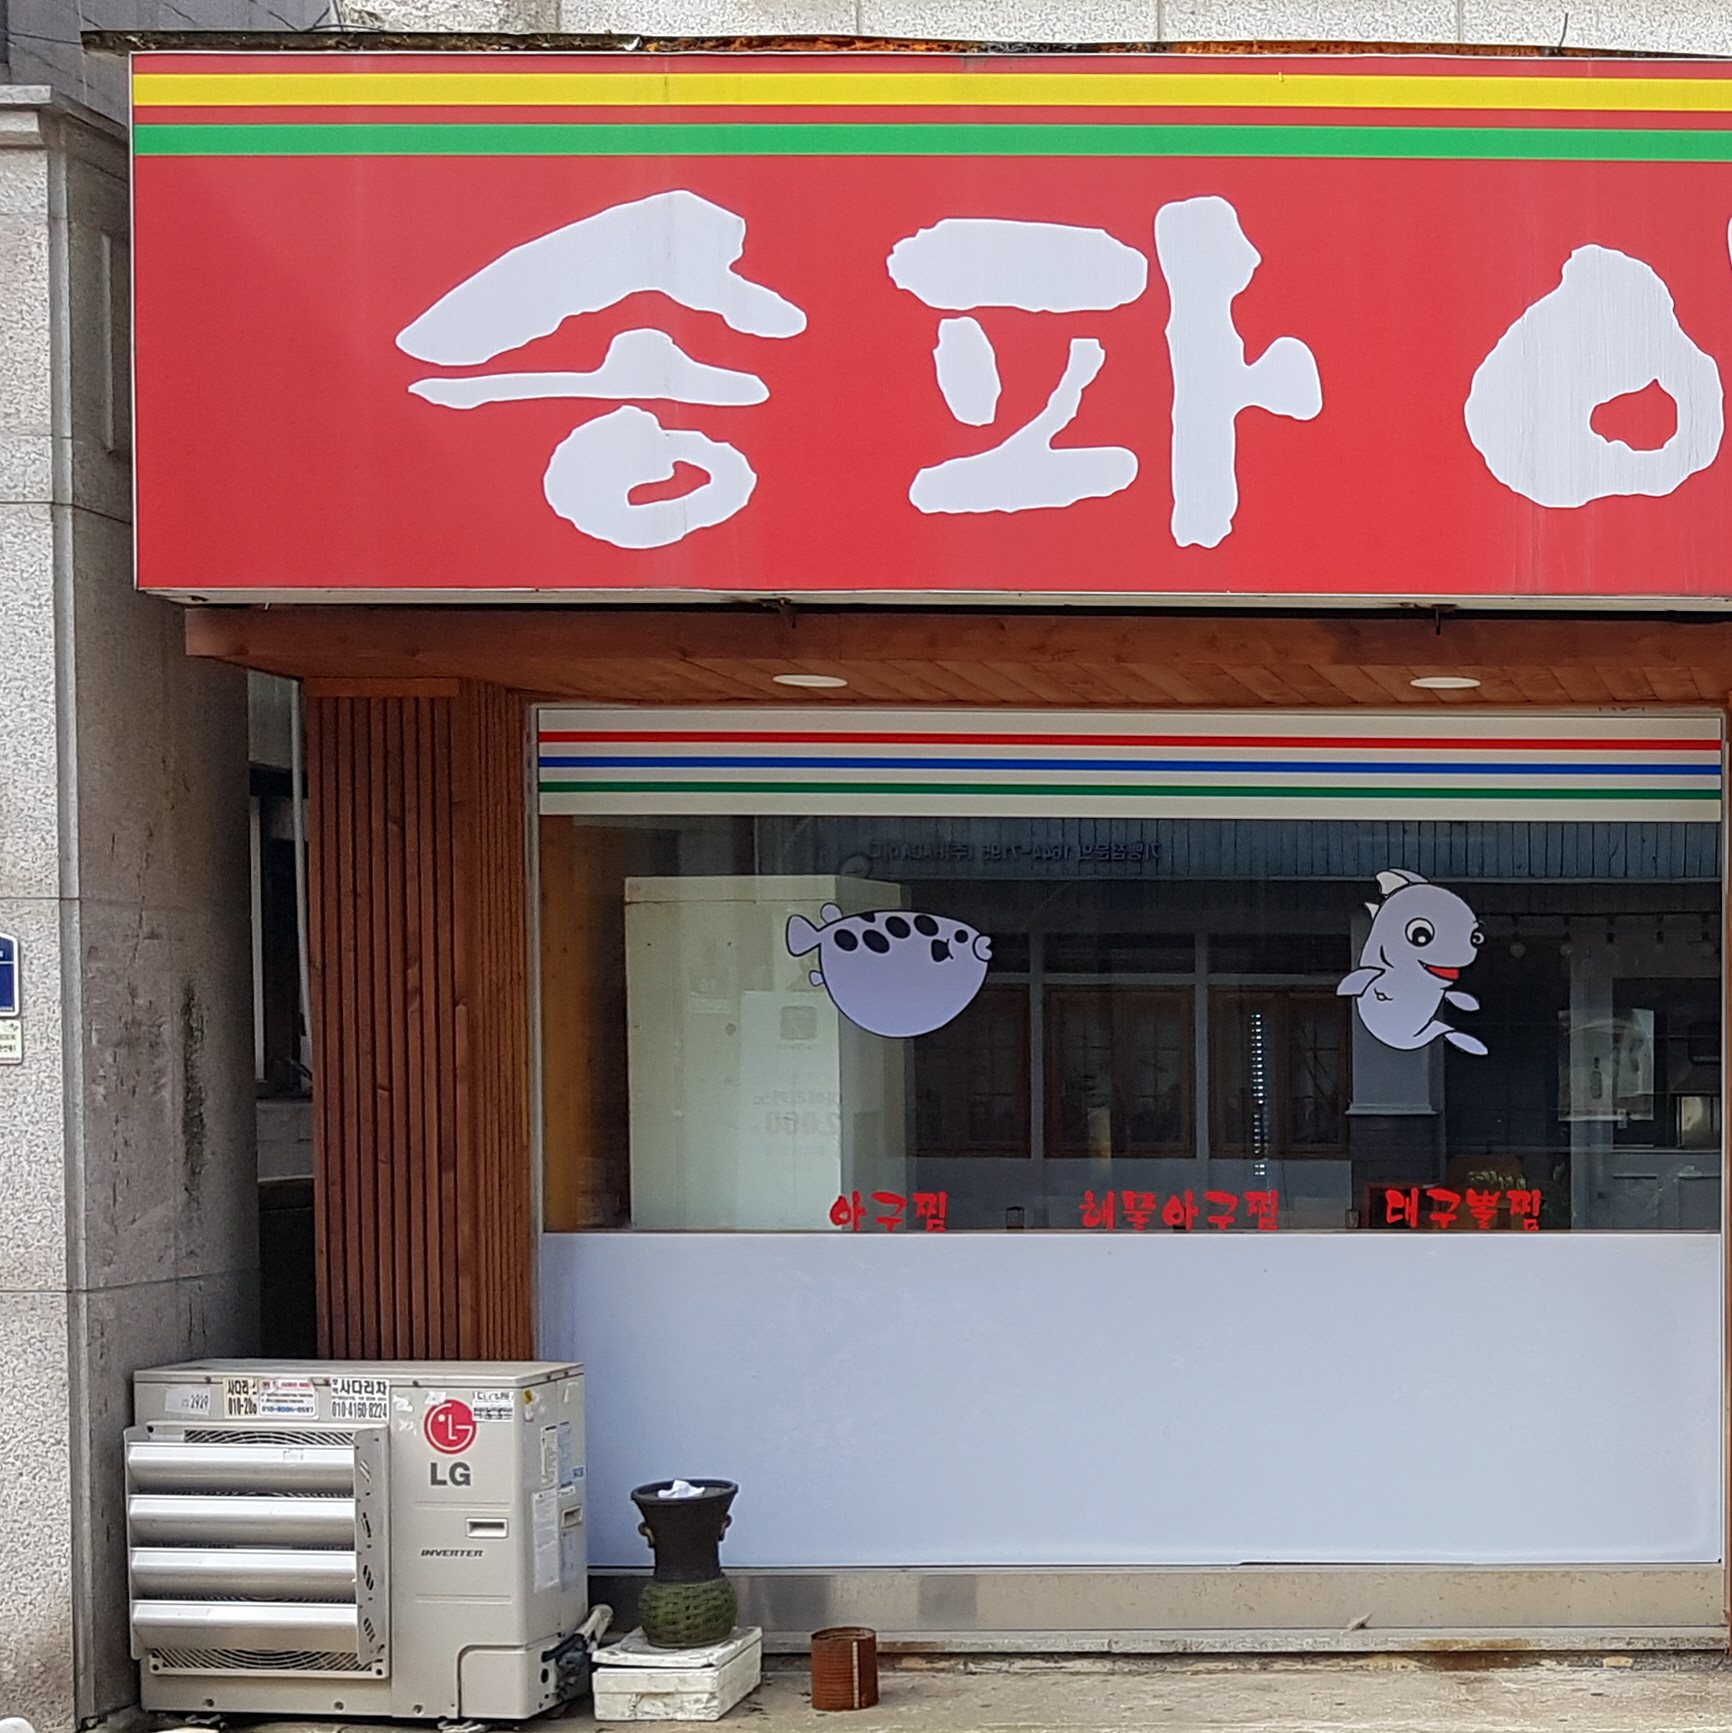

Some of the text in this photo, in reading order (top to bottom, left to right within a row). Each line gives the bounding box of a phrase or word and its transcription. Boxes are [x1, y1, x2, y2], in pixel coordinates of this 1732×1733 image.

[396, 190, 1322, 549] 송파
[829, 1191, 947, 1232] 아구찜
[1080, 1190, 1279, 1232] 해물아구찜
[1385, 1187, 1542, 1232] 대구뽈찜
[430, 1462, 472, 1486] LG
